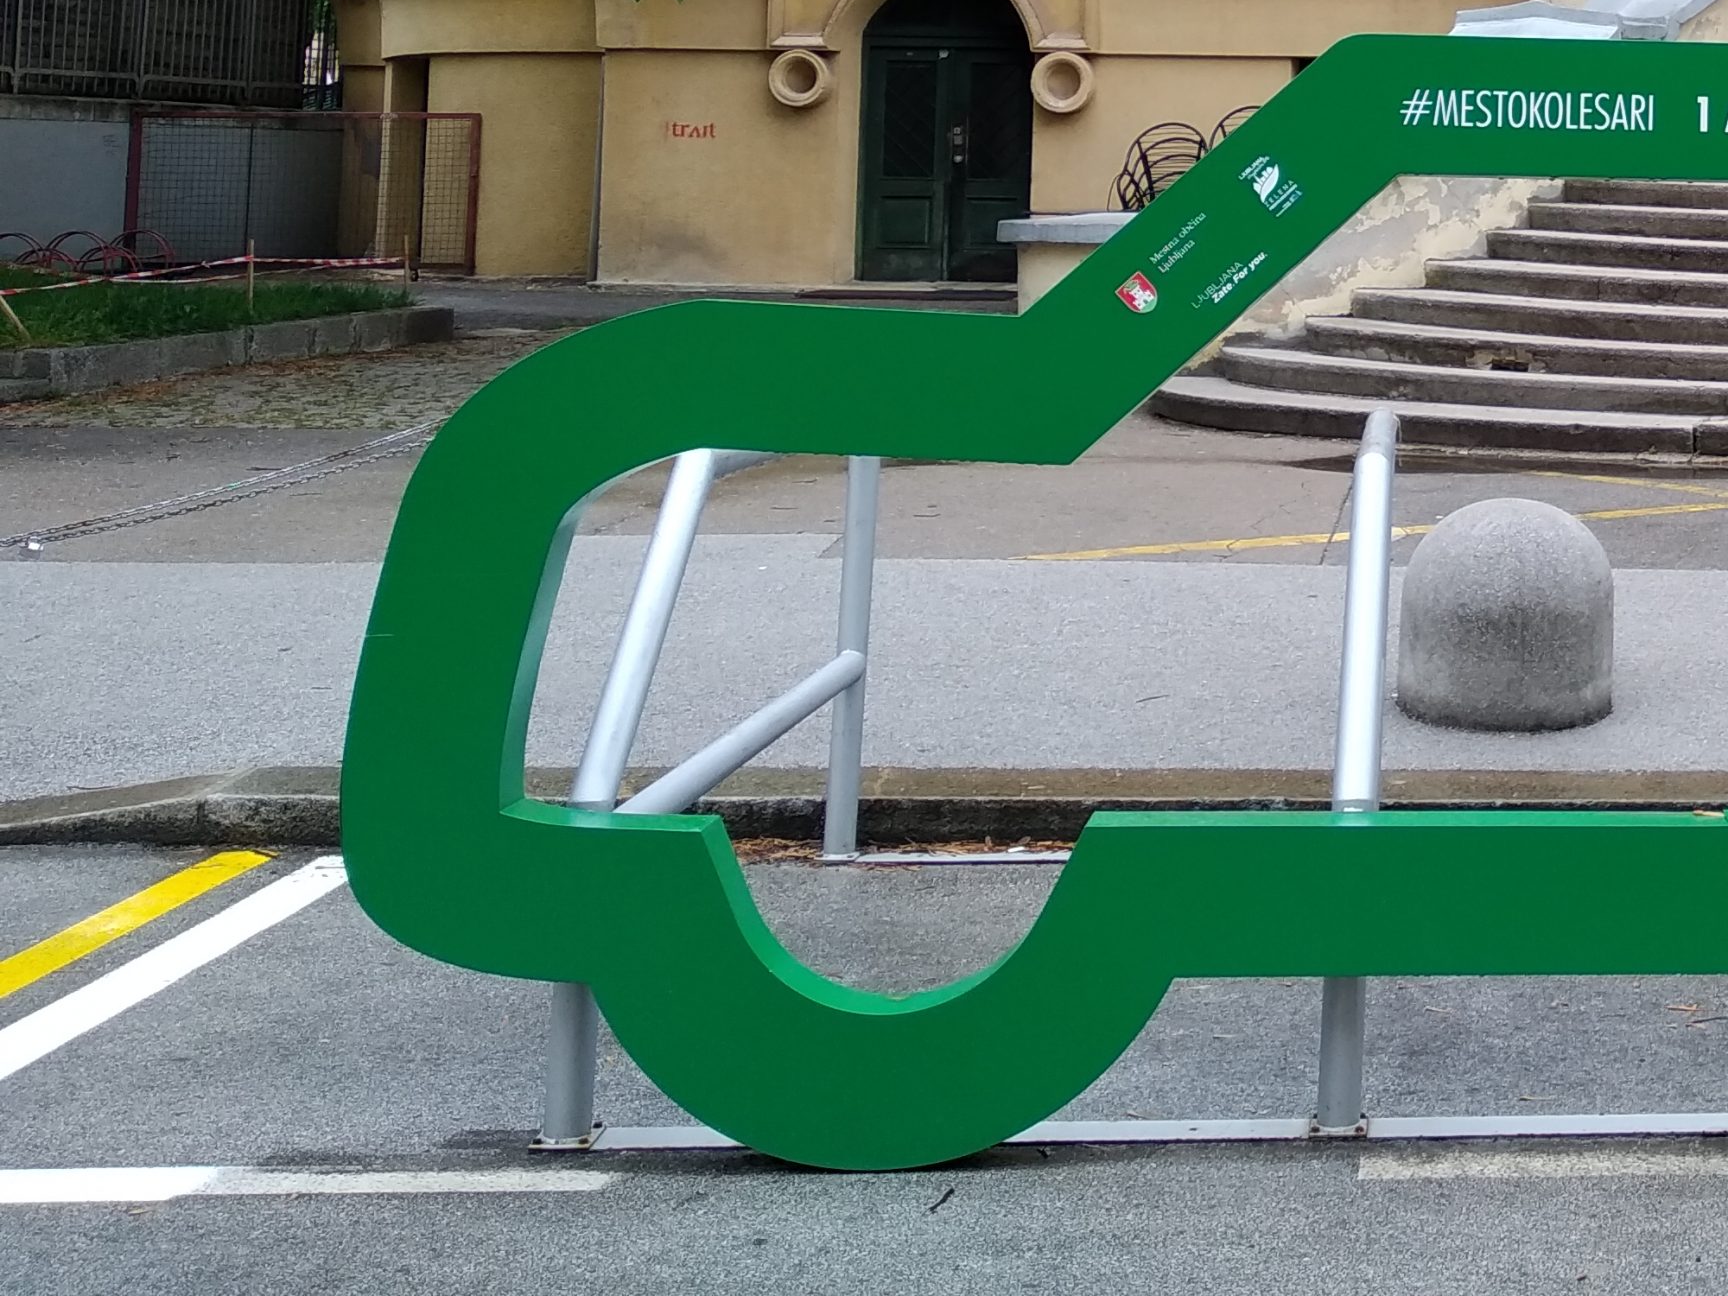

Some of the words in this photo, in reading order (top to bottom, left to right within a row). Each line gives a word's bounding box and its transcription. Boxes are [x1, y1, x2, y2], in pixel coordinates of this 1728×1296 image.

[1400, 89, 1655, 131] #MESTOKOLESARI
[1696, 95, 1709, 133] 1
[1149, 237, 1180, 264] Mestna
[1178, 212, 1206, 238] občina
[1157, 239, 1195, 273] Ljubljana
[1191, 262, 1243, 309] LJUBLJANA
[1232, 267, 1249, 284] For
